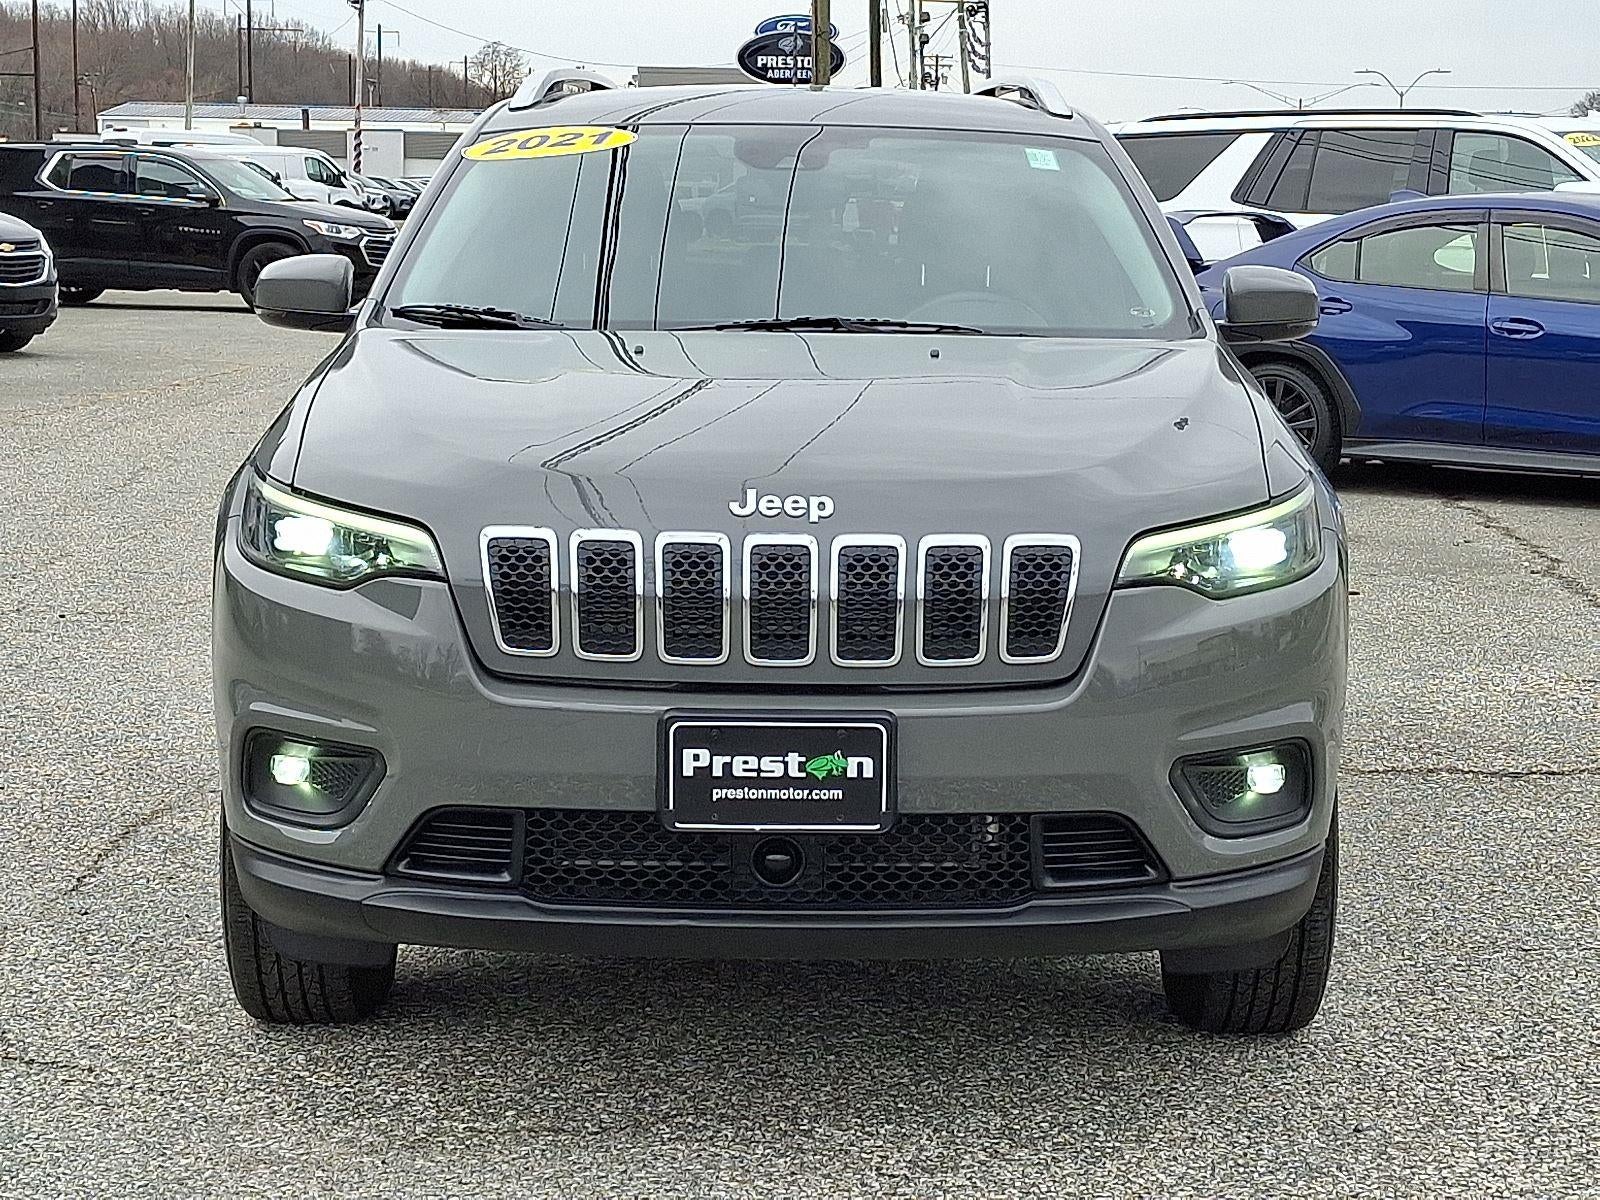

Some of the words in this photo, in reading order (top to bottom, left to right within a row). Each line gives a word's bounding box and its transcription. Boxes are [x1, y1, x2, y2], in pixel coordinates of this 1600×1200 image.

[757, 55, 813, 68] PRESTO
[481, 131, 614, 156] 2021
[728, 488, 835, 524] Jeep
[712, 787, 843, 802] prestonmotor.com
